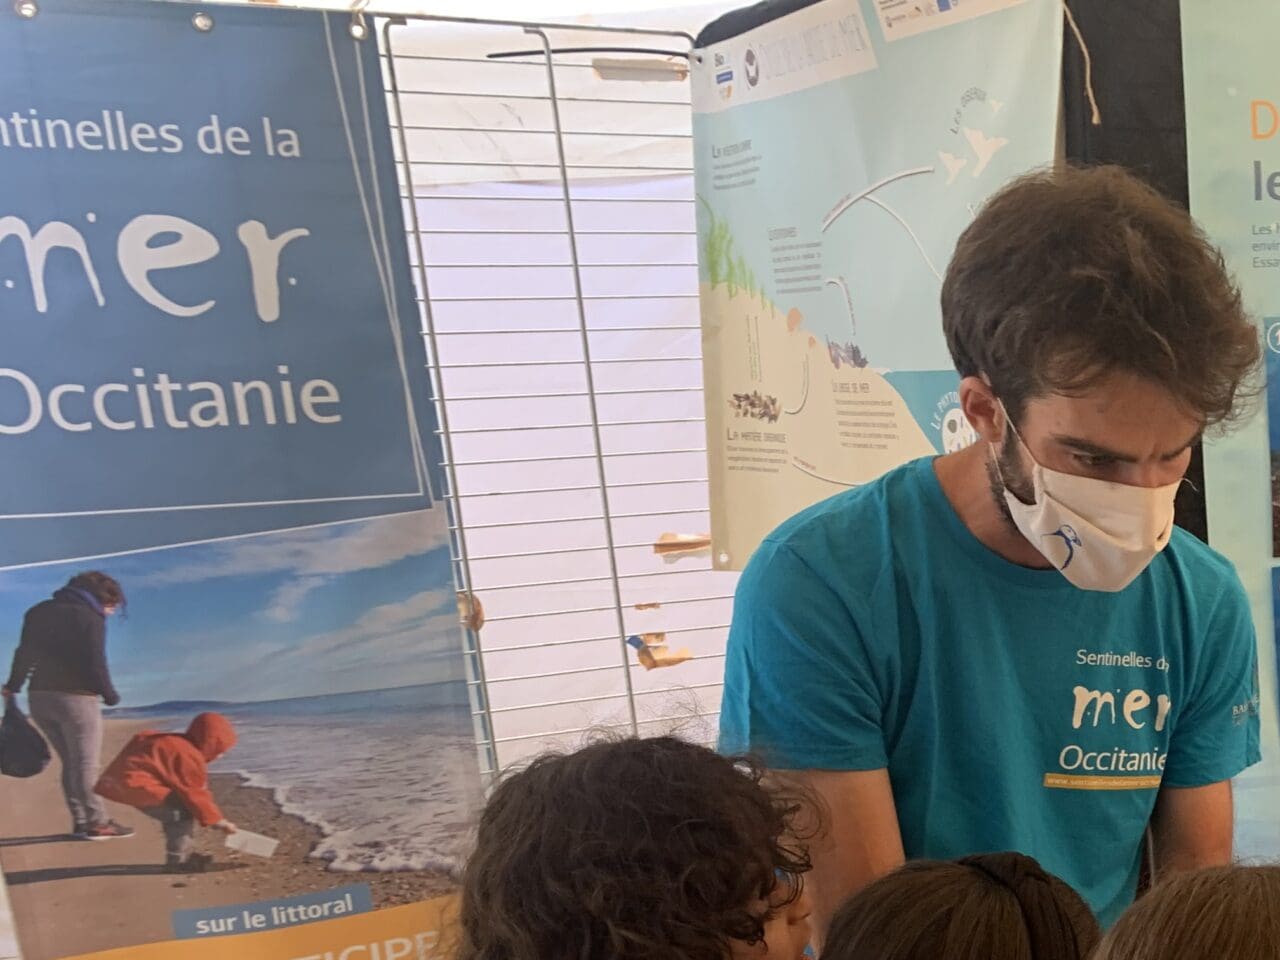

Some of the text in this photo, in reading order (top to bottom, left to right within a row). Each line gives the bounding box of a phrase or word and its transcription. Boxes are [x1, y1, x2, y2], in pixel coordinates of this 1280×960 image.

[197, 114, 251, 156] de
[262, 116, 301, 157] la
[0, 213, 310, 322] mer
[0, 364, 343, 435] Occitanie
[1075, 649, 1152, 668] Sentinelles
[1059, 745, 1167, 771] Occitanie
[195, 893, 354, 935] sur le littoral
